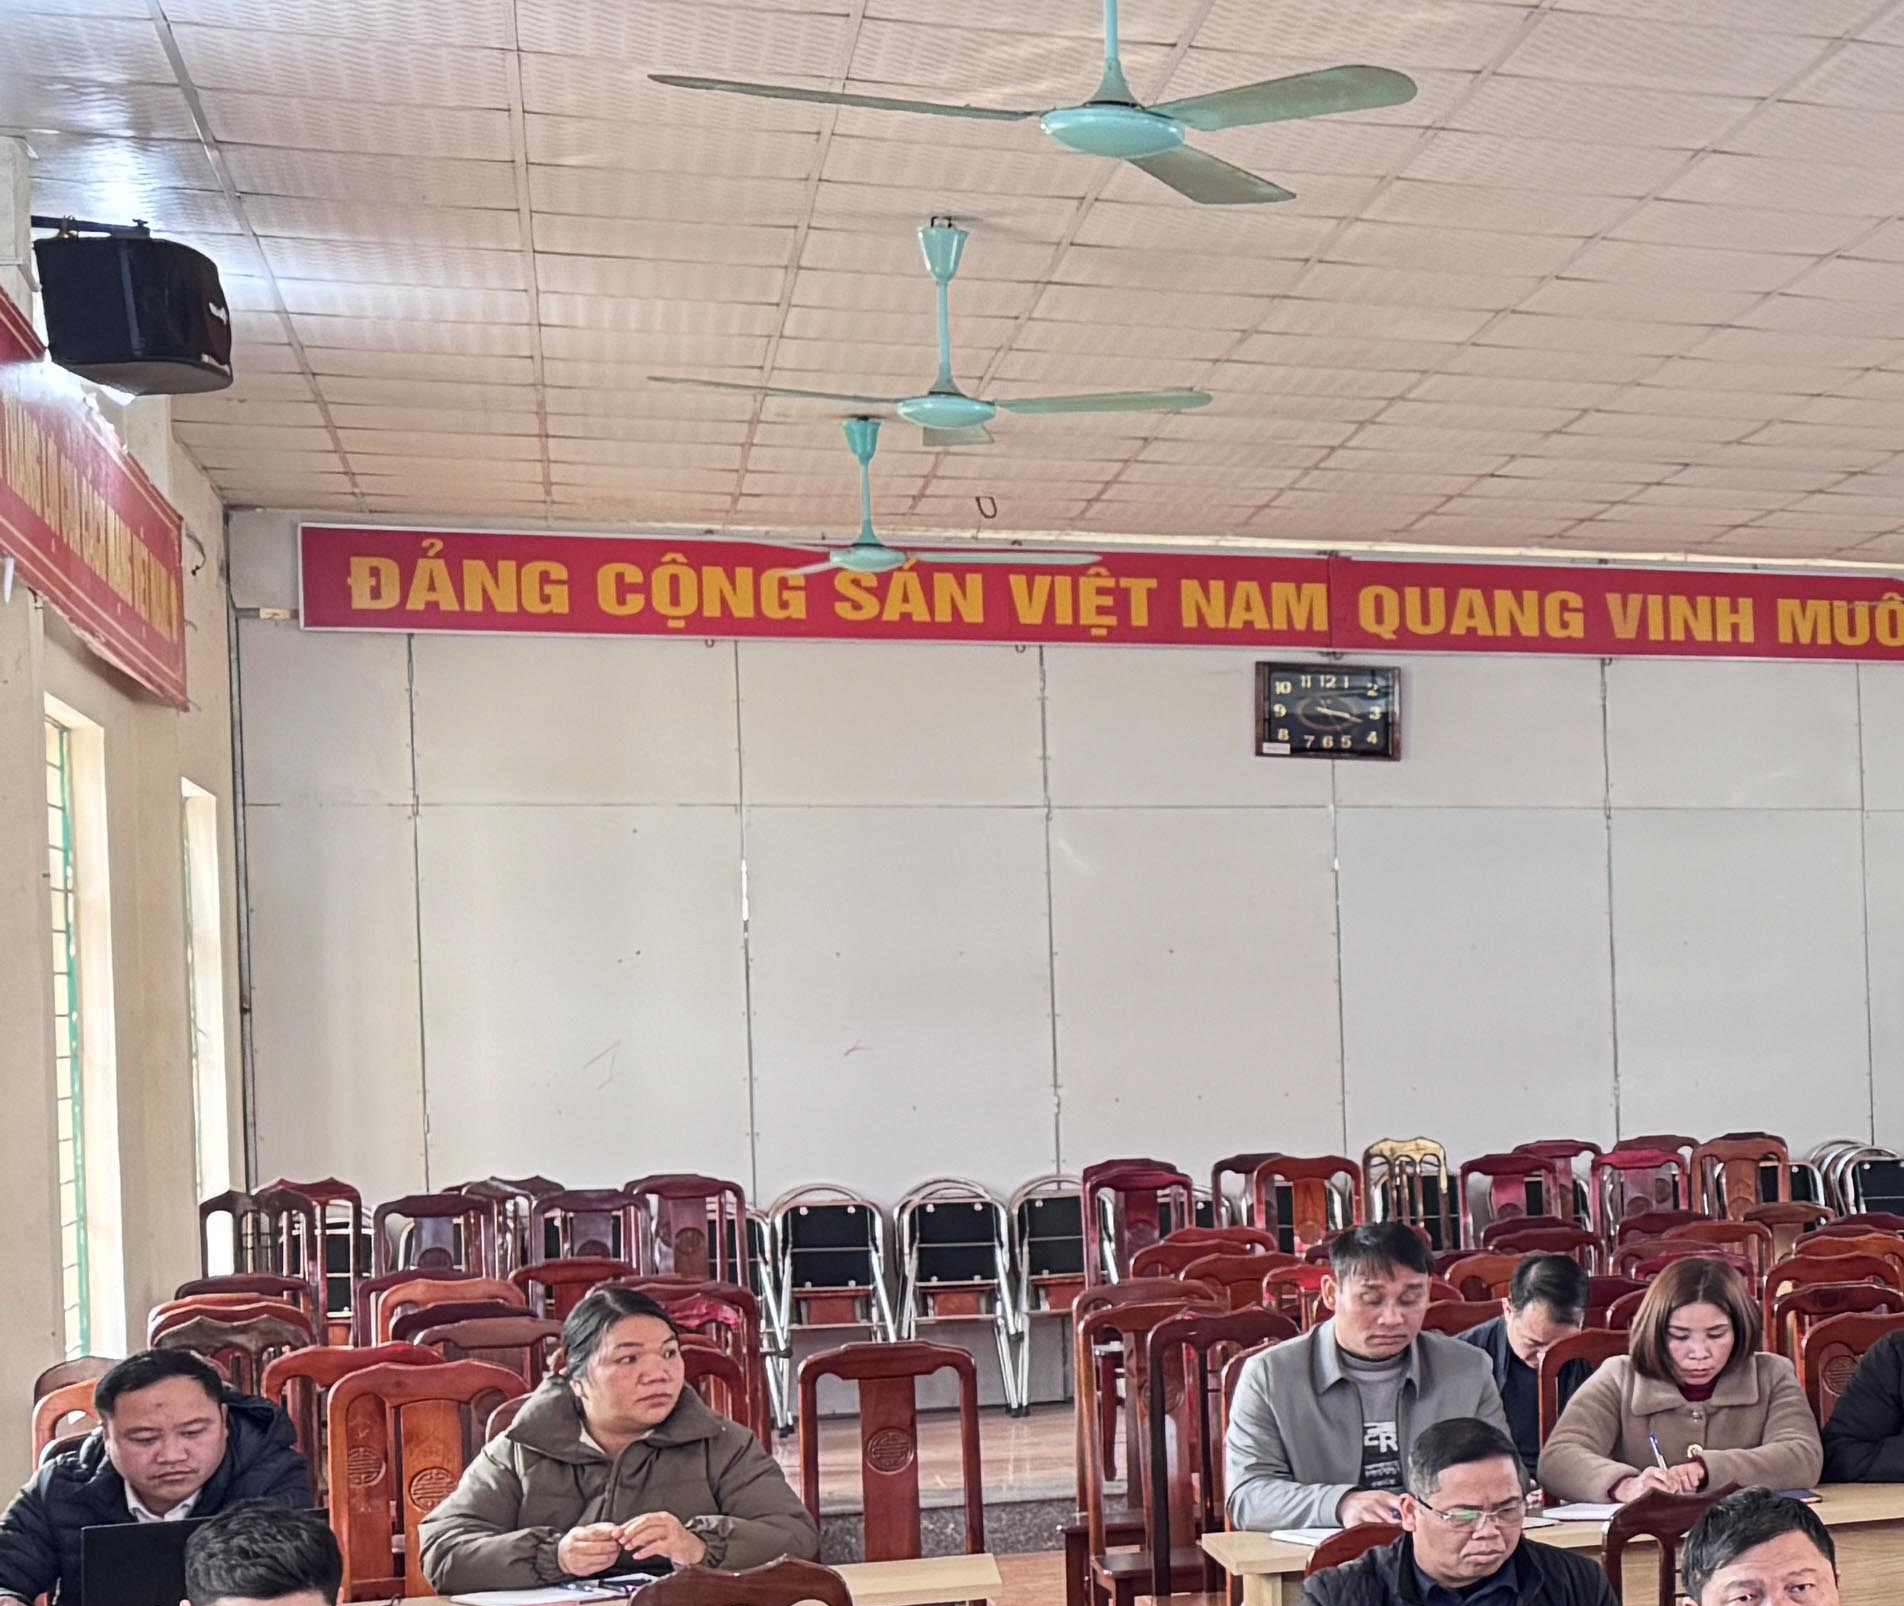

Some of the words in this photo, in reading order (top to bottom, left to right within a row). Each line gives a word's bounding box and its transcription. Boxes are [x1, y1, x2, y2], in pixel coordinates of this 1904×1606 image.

[347, 538, 569, 614] ĐẢNG
[596, 552, 807, 628] CỘNG
[1009, 566, 1158, 636] VIỆT
[1181, 579, 1329, 632] NAM
[1358, 585, 1584, 640] QUANG
[1605, 593, 1754, 643] VINH
[1275, 681, 1292, 694] 10
[1320, 675, 1337, 688] 12
[1273, 703, 1287, 718] 9
[1369, 706, 1381, 721] 3
[1304, 735, 1315, 749] 7
[1322, 735, 1334, 749] 6
[1341, 735, 1352, 749] 5
[1366, 730, 1378, 744] 4
